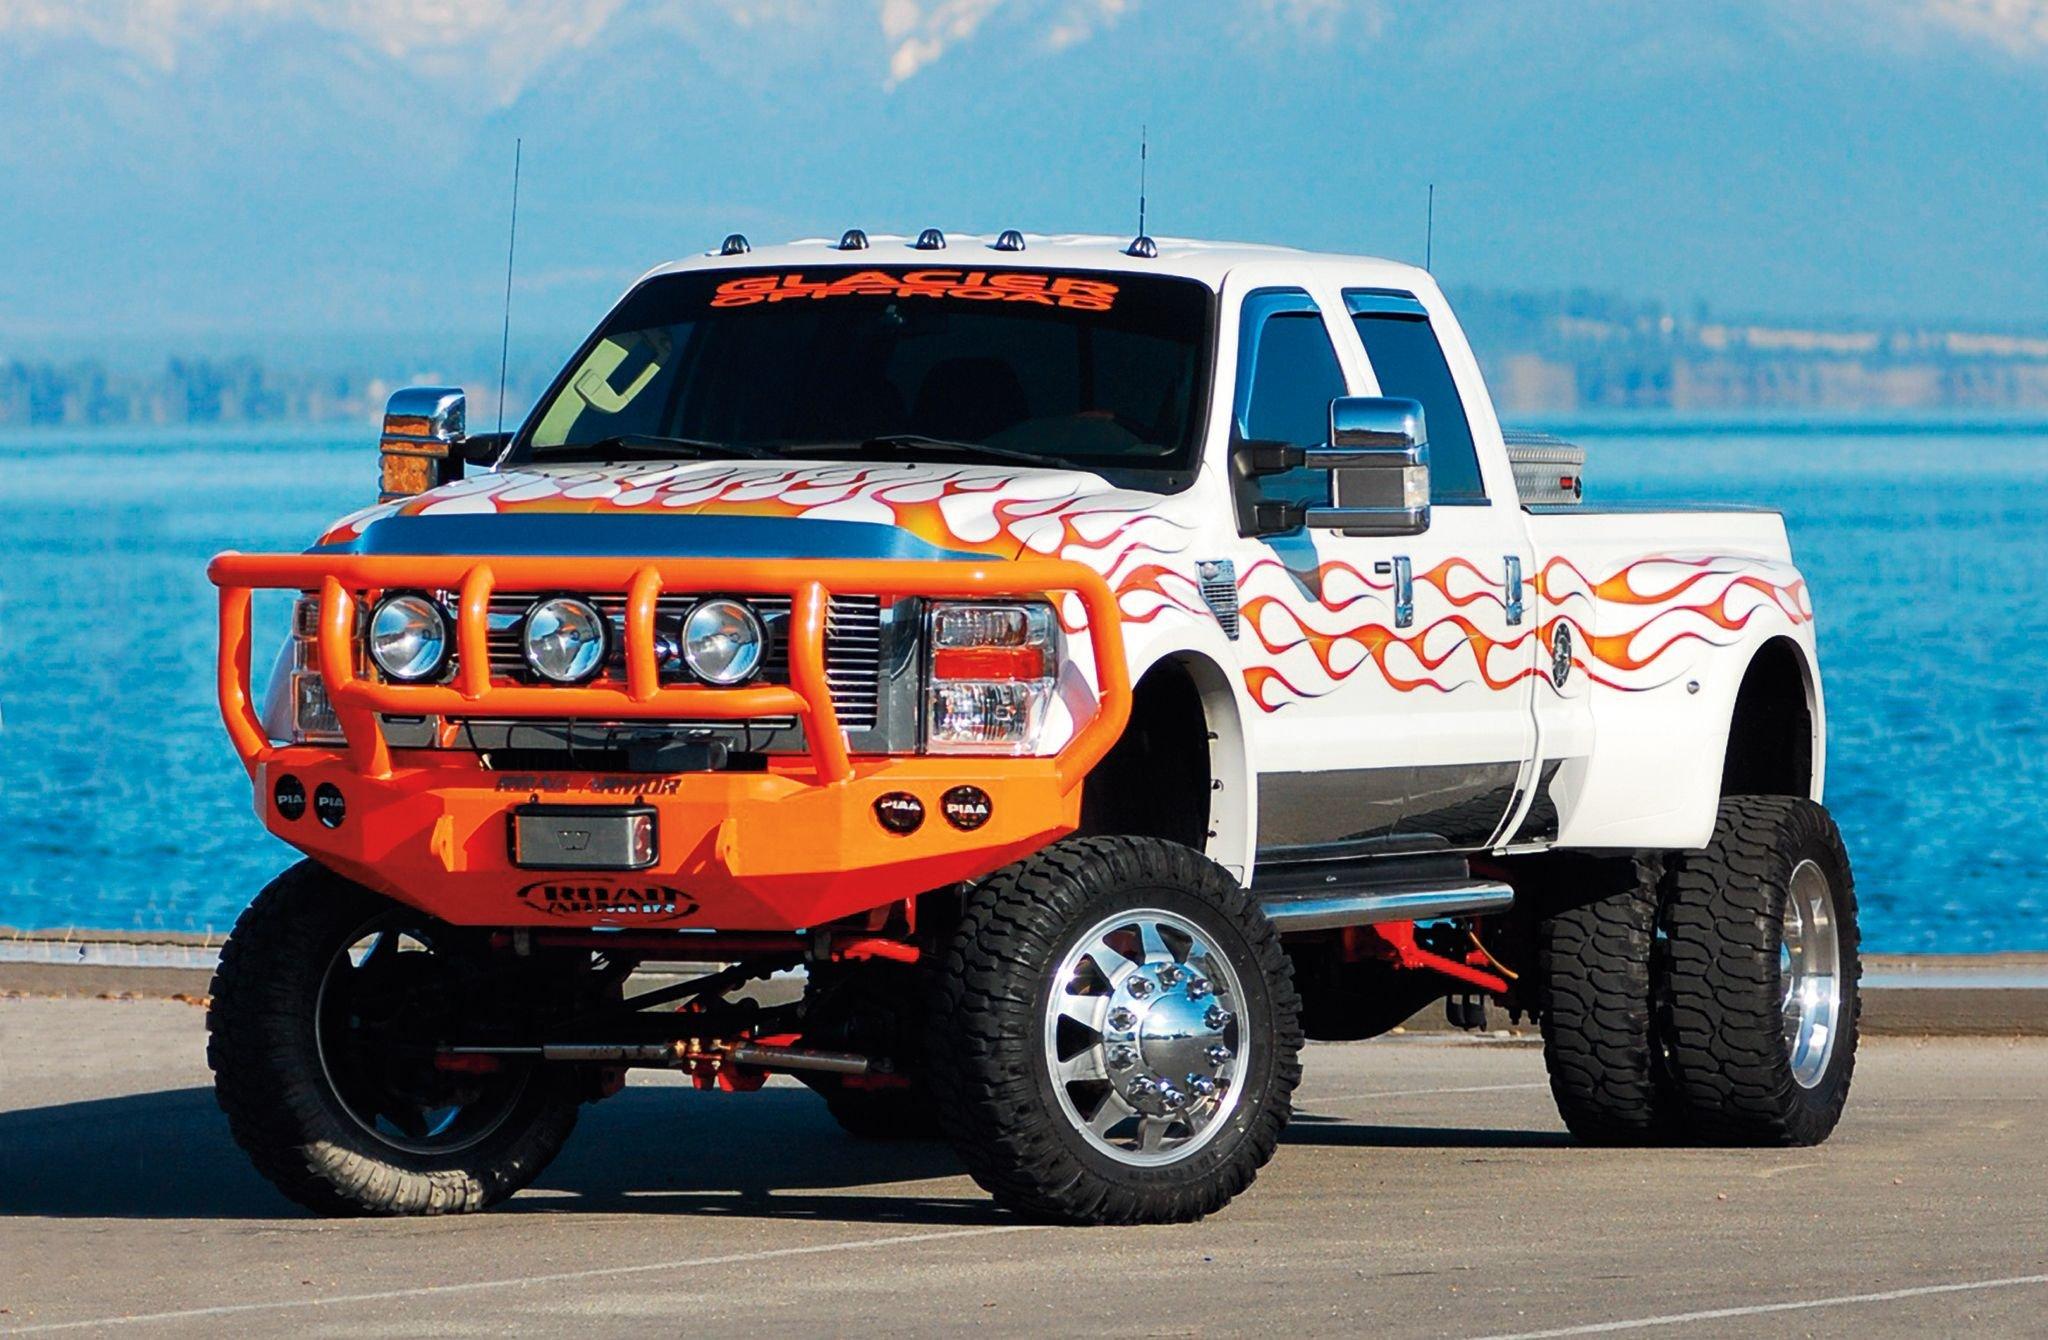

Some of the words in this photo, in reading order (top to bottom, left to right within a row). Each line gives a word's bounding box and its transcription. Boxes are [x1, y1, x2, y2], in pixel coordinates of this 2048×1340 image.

[716, 271, 1119, 302] GLACIER
[277, 794, 304, 805] PIA
[318, 796, 344, 807] PIA
[881, 800, 921, 811] PIAA
[947, 803, 988, 814] PIAA
[544, 886, 677, 902] ROAD
